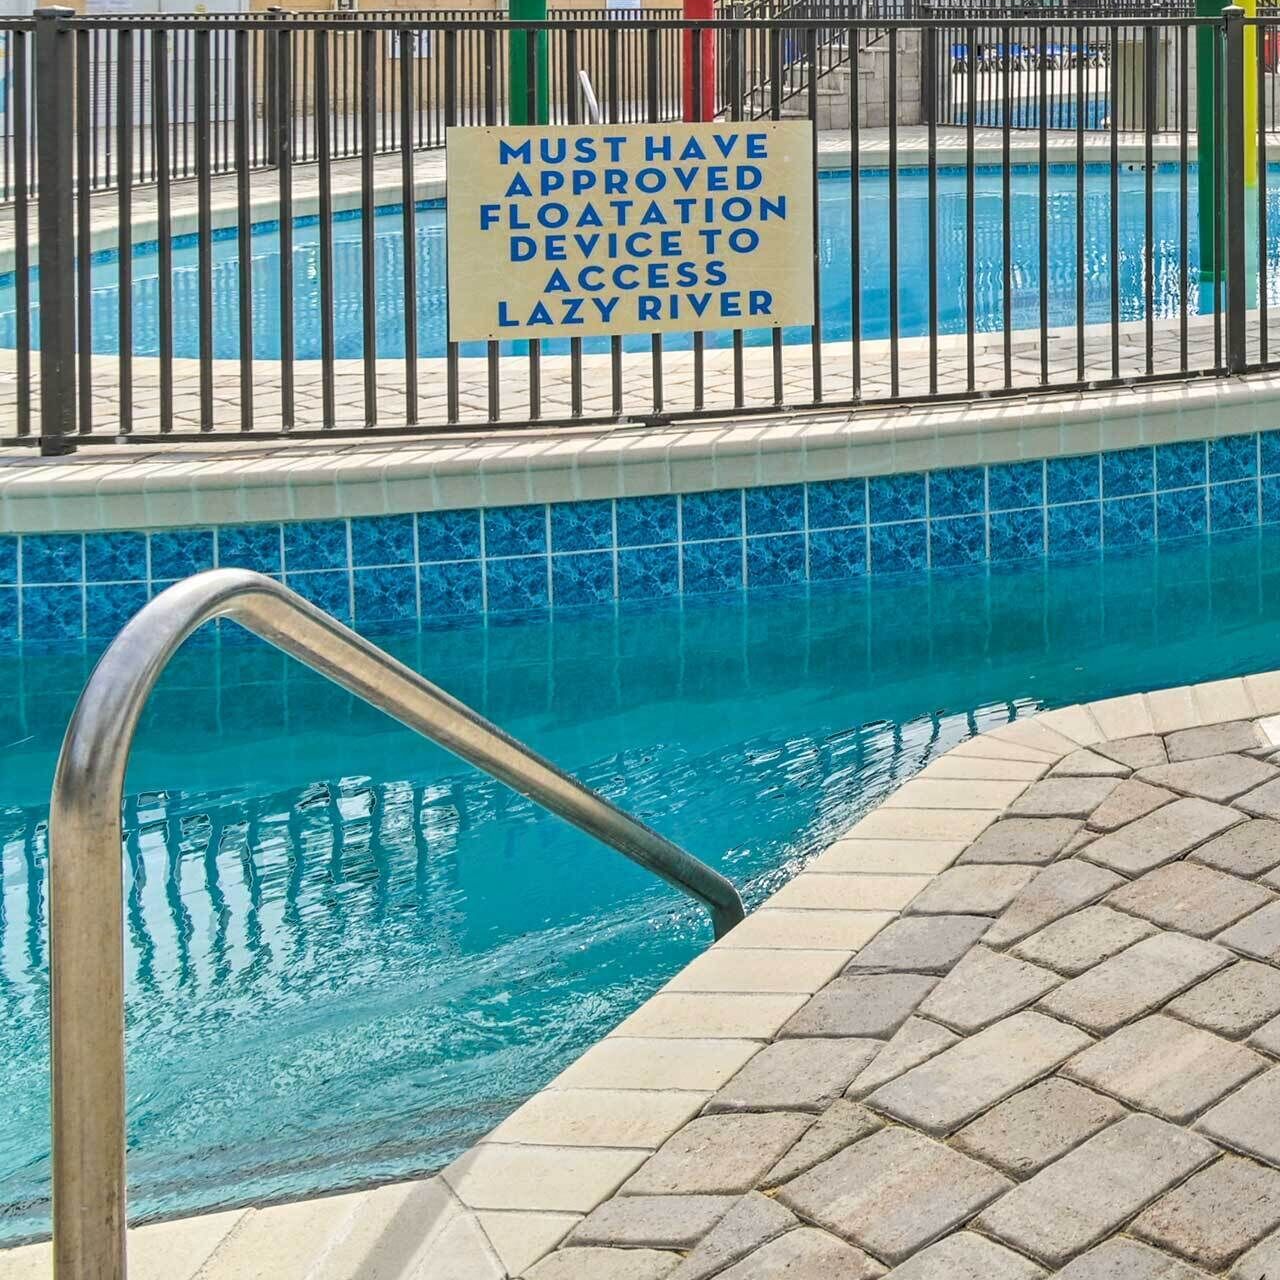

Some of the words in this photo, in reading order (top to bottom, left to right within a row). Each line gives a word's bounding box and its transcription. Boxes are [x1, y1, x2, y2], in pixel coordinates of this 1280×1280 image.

[499, 136, 628, 166] MUST
[645, 133, 768, 162] HAVE
[504, 164, 763, 199] APPROVED
[479, 195, 788, 231] FLOATATION
[510, 230, 683, 263] DEVICE
[699, 227, 761, 256] TO
[543, 260, 728, 294] ACCESS
[498, 296, 620, 328] LAZY
[637, 289, 774, 322] RIVER
